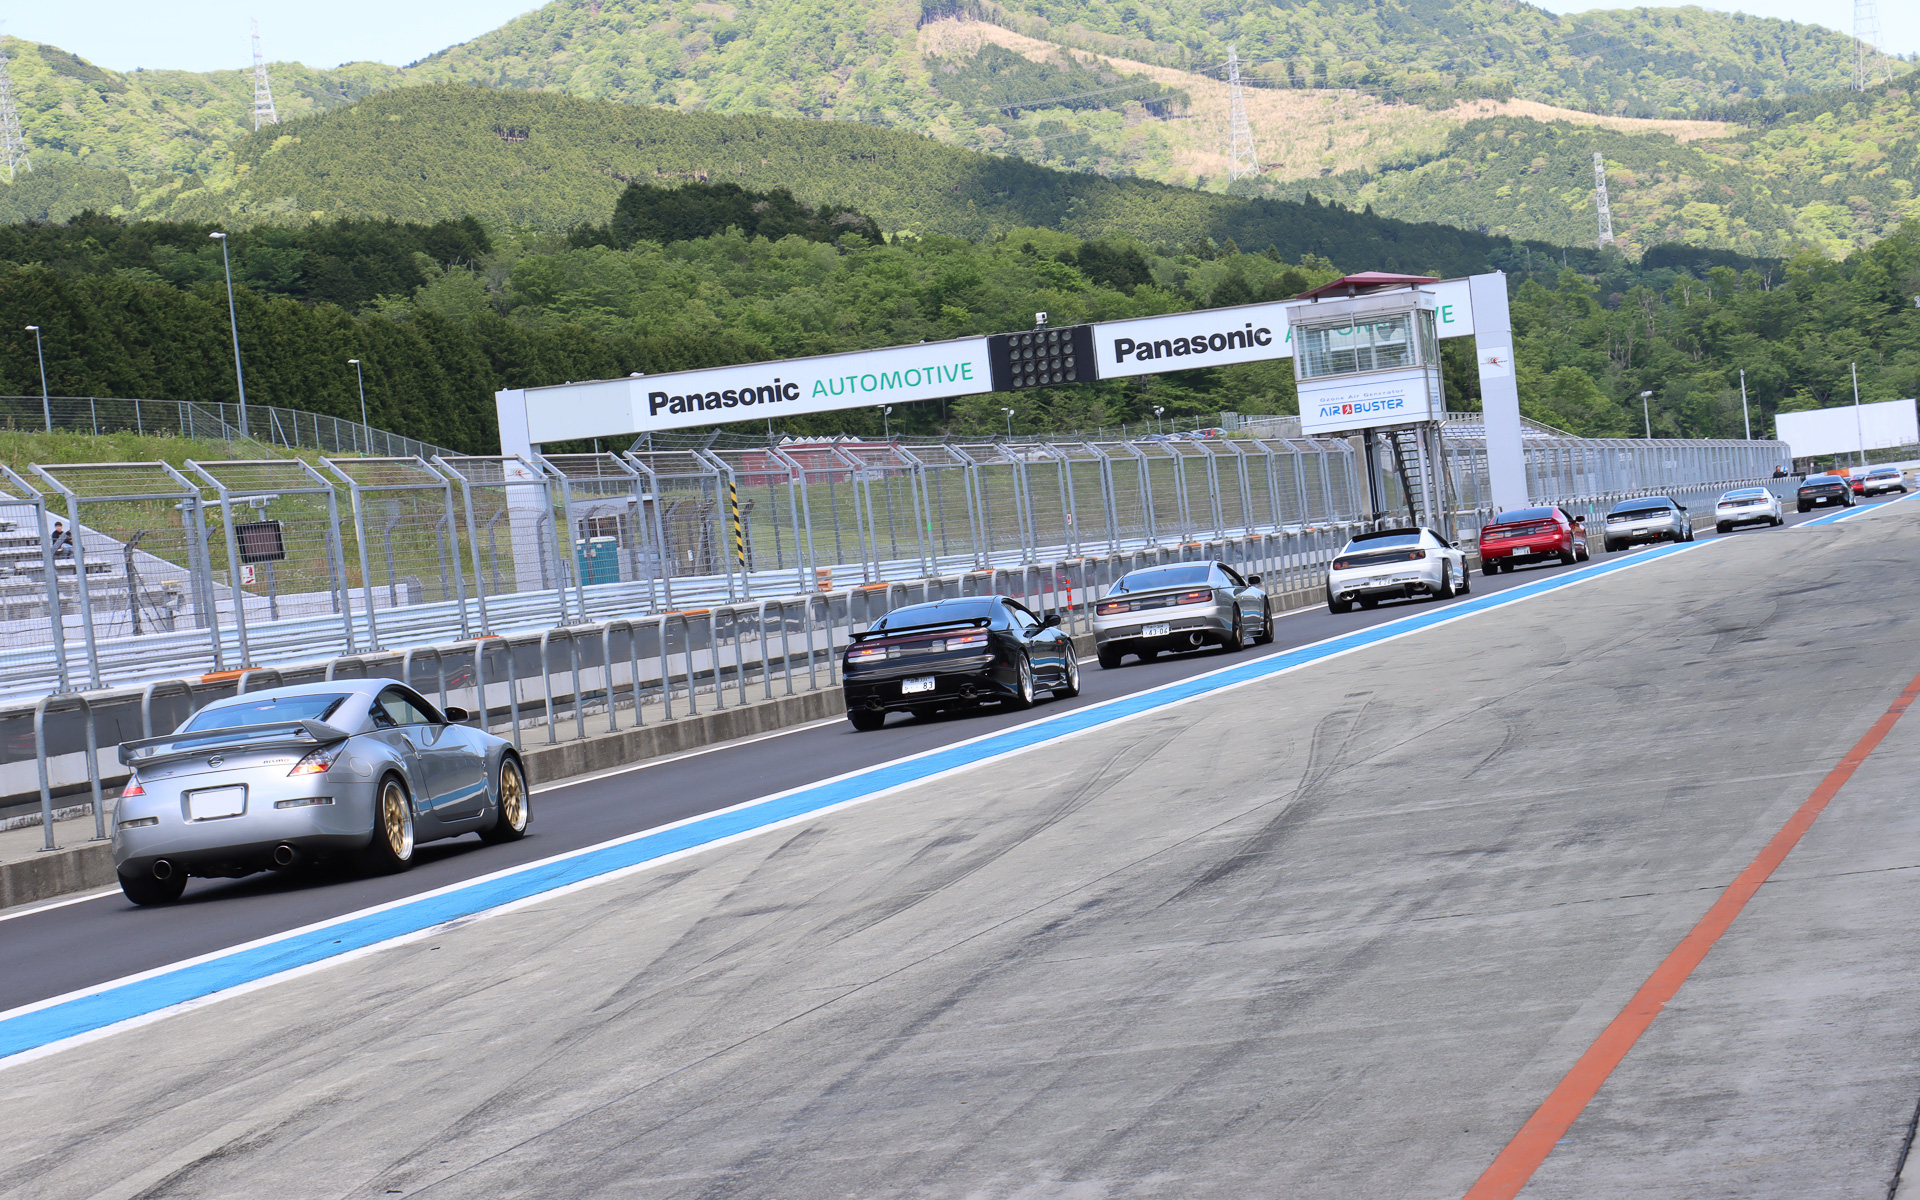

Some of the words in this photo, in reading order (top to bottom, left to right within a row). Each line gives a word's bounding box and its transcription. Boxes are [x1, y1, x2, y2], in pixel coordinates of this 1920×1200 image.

[1114, 323, 1273, 364] Panasonic
[648, 378, 800, 416] Panasonic
[812, 362, 974, 398] AUTOMOTIVE
[1319, 405, 1341, 417] AIR
[1354, 398, 1404, 413] BUSTER
